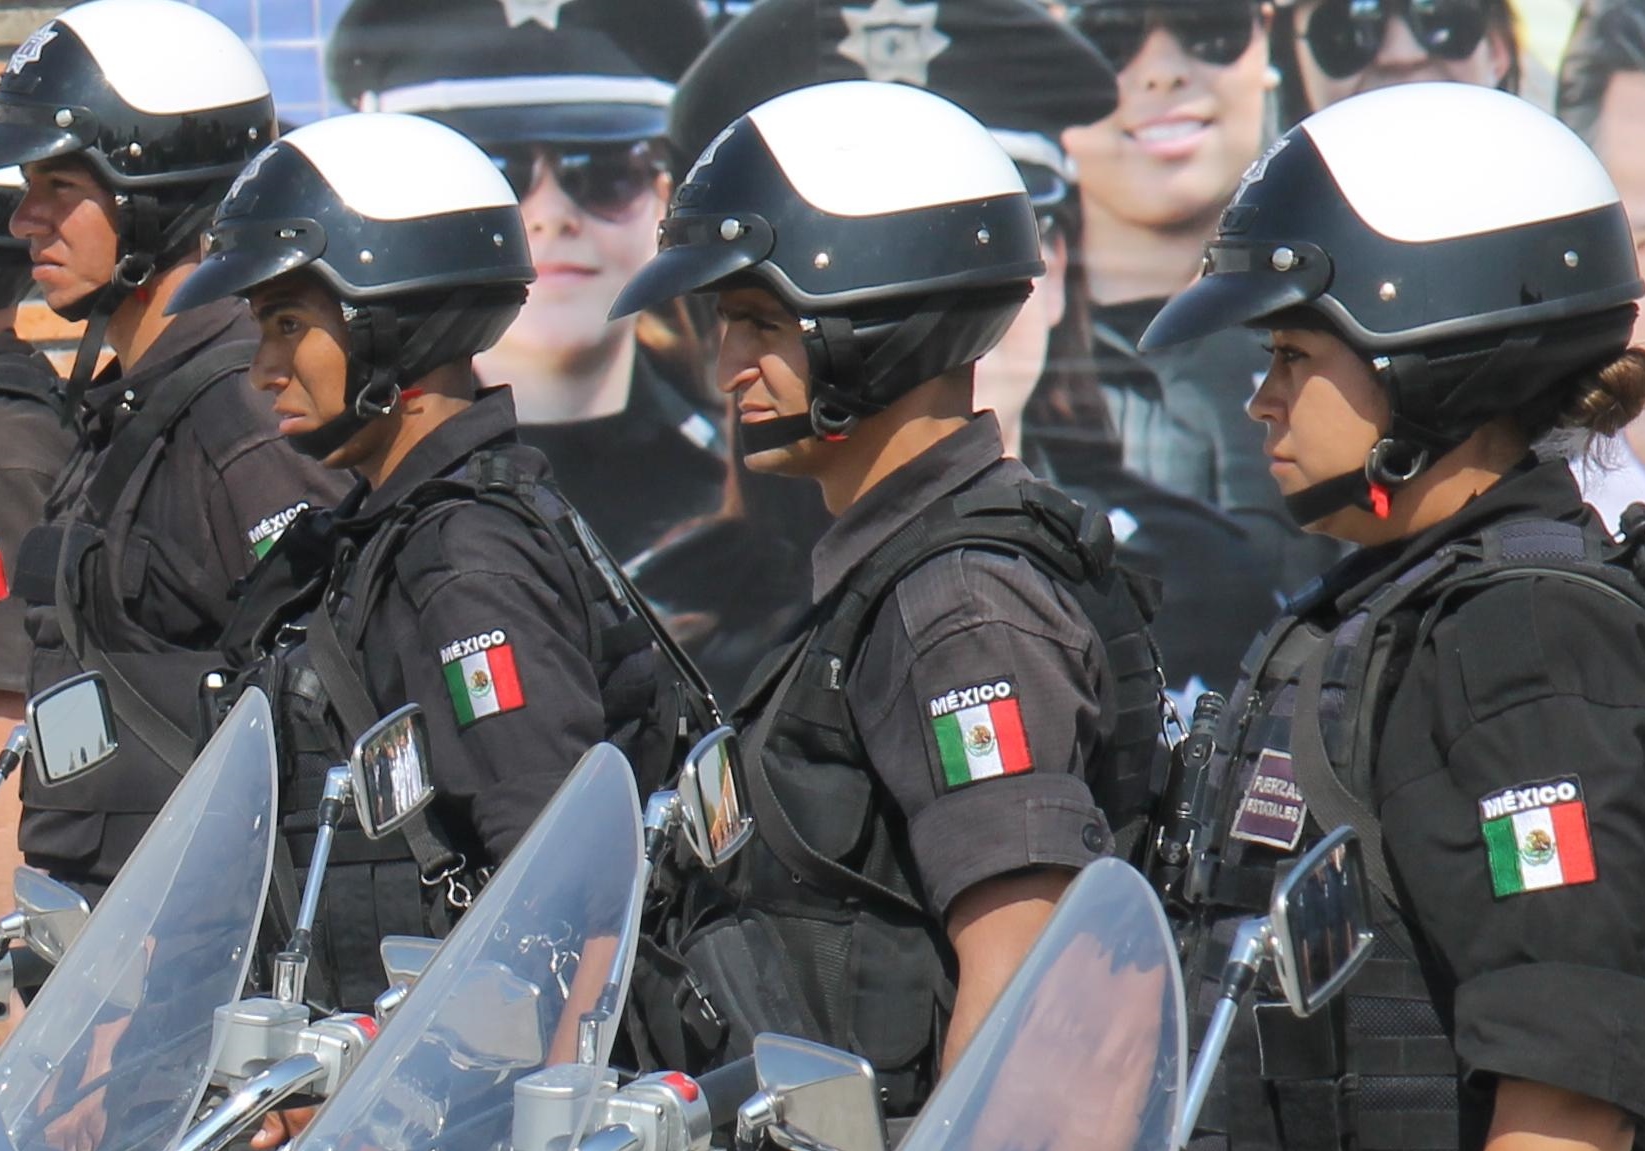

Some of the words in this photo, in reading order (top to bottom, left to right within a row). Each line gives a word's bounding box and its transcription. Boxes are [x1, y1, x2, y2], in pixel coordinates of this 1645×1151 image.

[440, 630, 505, 664] MÉXICO
[930, 681, 1011, 717] MÉXICO
[1482, 782, 1576, 819] MÉXICO
